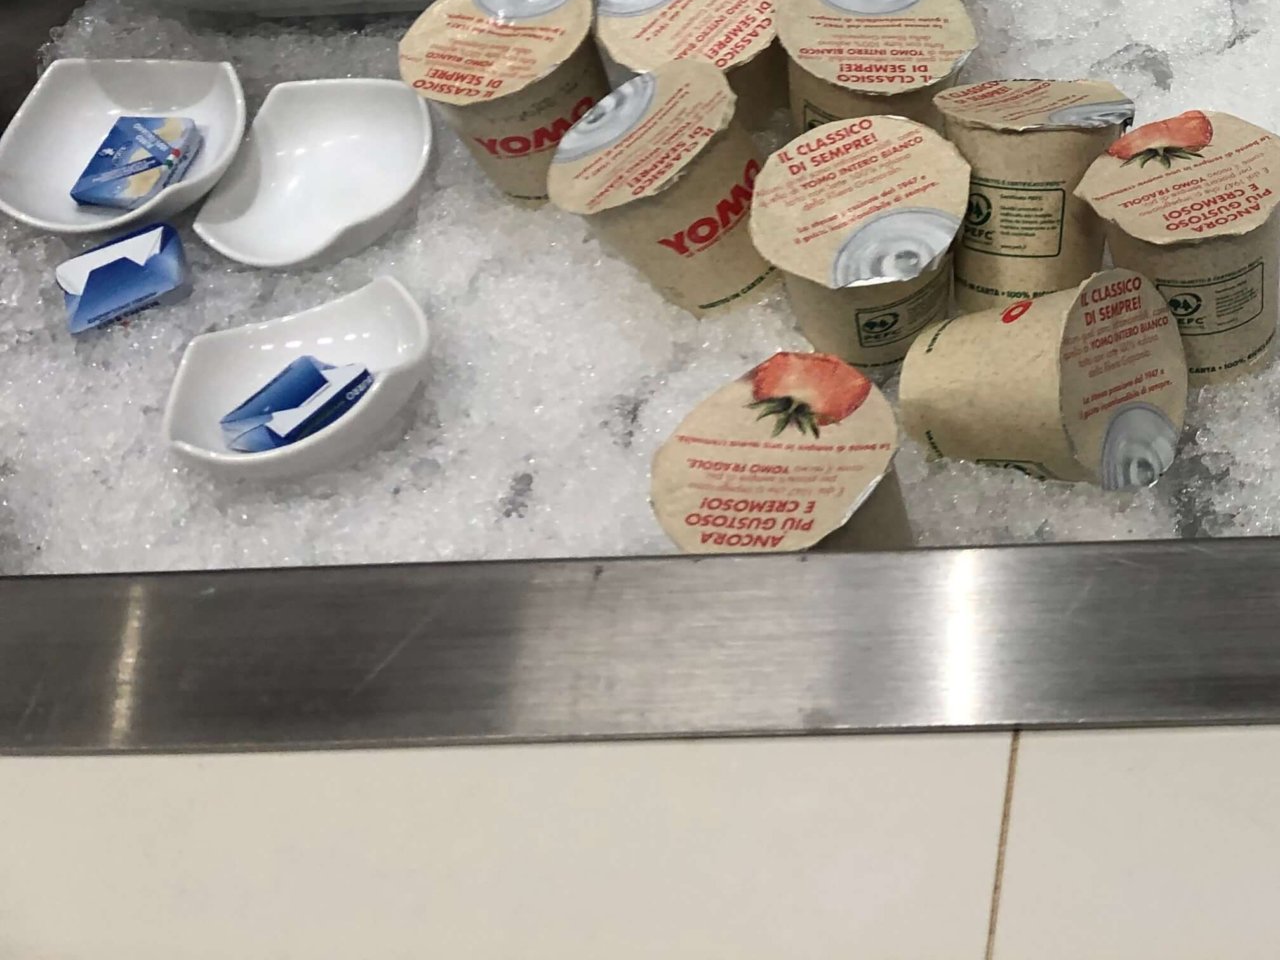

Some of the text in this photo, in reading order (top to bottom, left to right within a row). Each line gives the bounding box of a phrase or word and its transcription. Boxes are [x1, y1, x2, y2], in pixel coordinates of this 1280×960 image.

[702, 0, 773, 60] DI SEMPRE!
[715, 17, 772, 68] CLASSICO
[426, 68, 503, 89] DI SEMPRE!
[837, 74, 916, 83] CLASSICO
[839, 63, 928, 73] DI SEMPRE!
[412, 79, 480, 97] CLASSICO
[777, 119, 873, 164] IL CLASSICO
[788, 133, 879, 176] DI SEMPRE!
[626, 141, 688, 188] SEMPRE!
[631, 141, 699, 196] CLASSICO
[1162, 183, 1260, 221] E CREMOSO!
[1165, 201, 1242, 231] GUSTOSO
[1191, 202, 1262, 233] ANCORA
[1080, 276, 1142, 308] IL CLASSICO
[1084, 296, 1142, 326] DI SEMPRE!
[701, 498, 817, 514] E CREMOSO!
[684, 513, 777, 530] GUSTOSO
[700, 532, 785, 547] ANCORA
